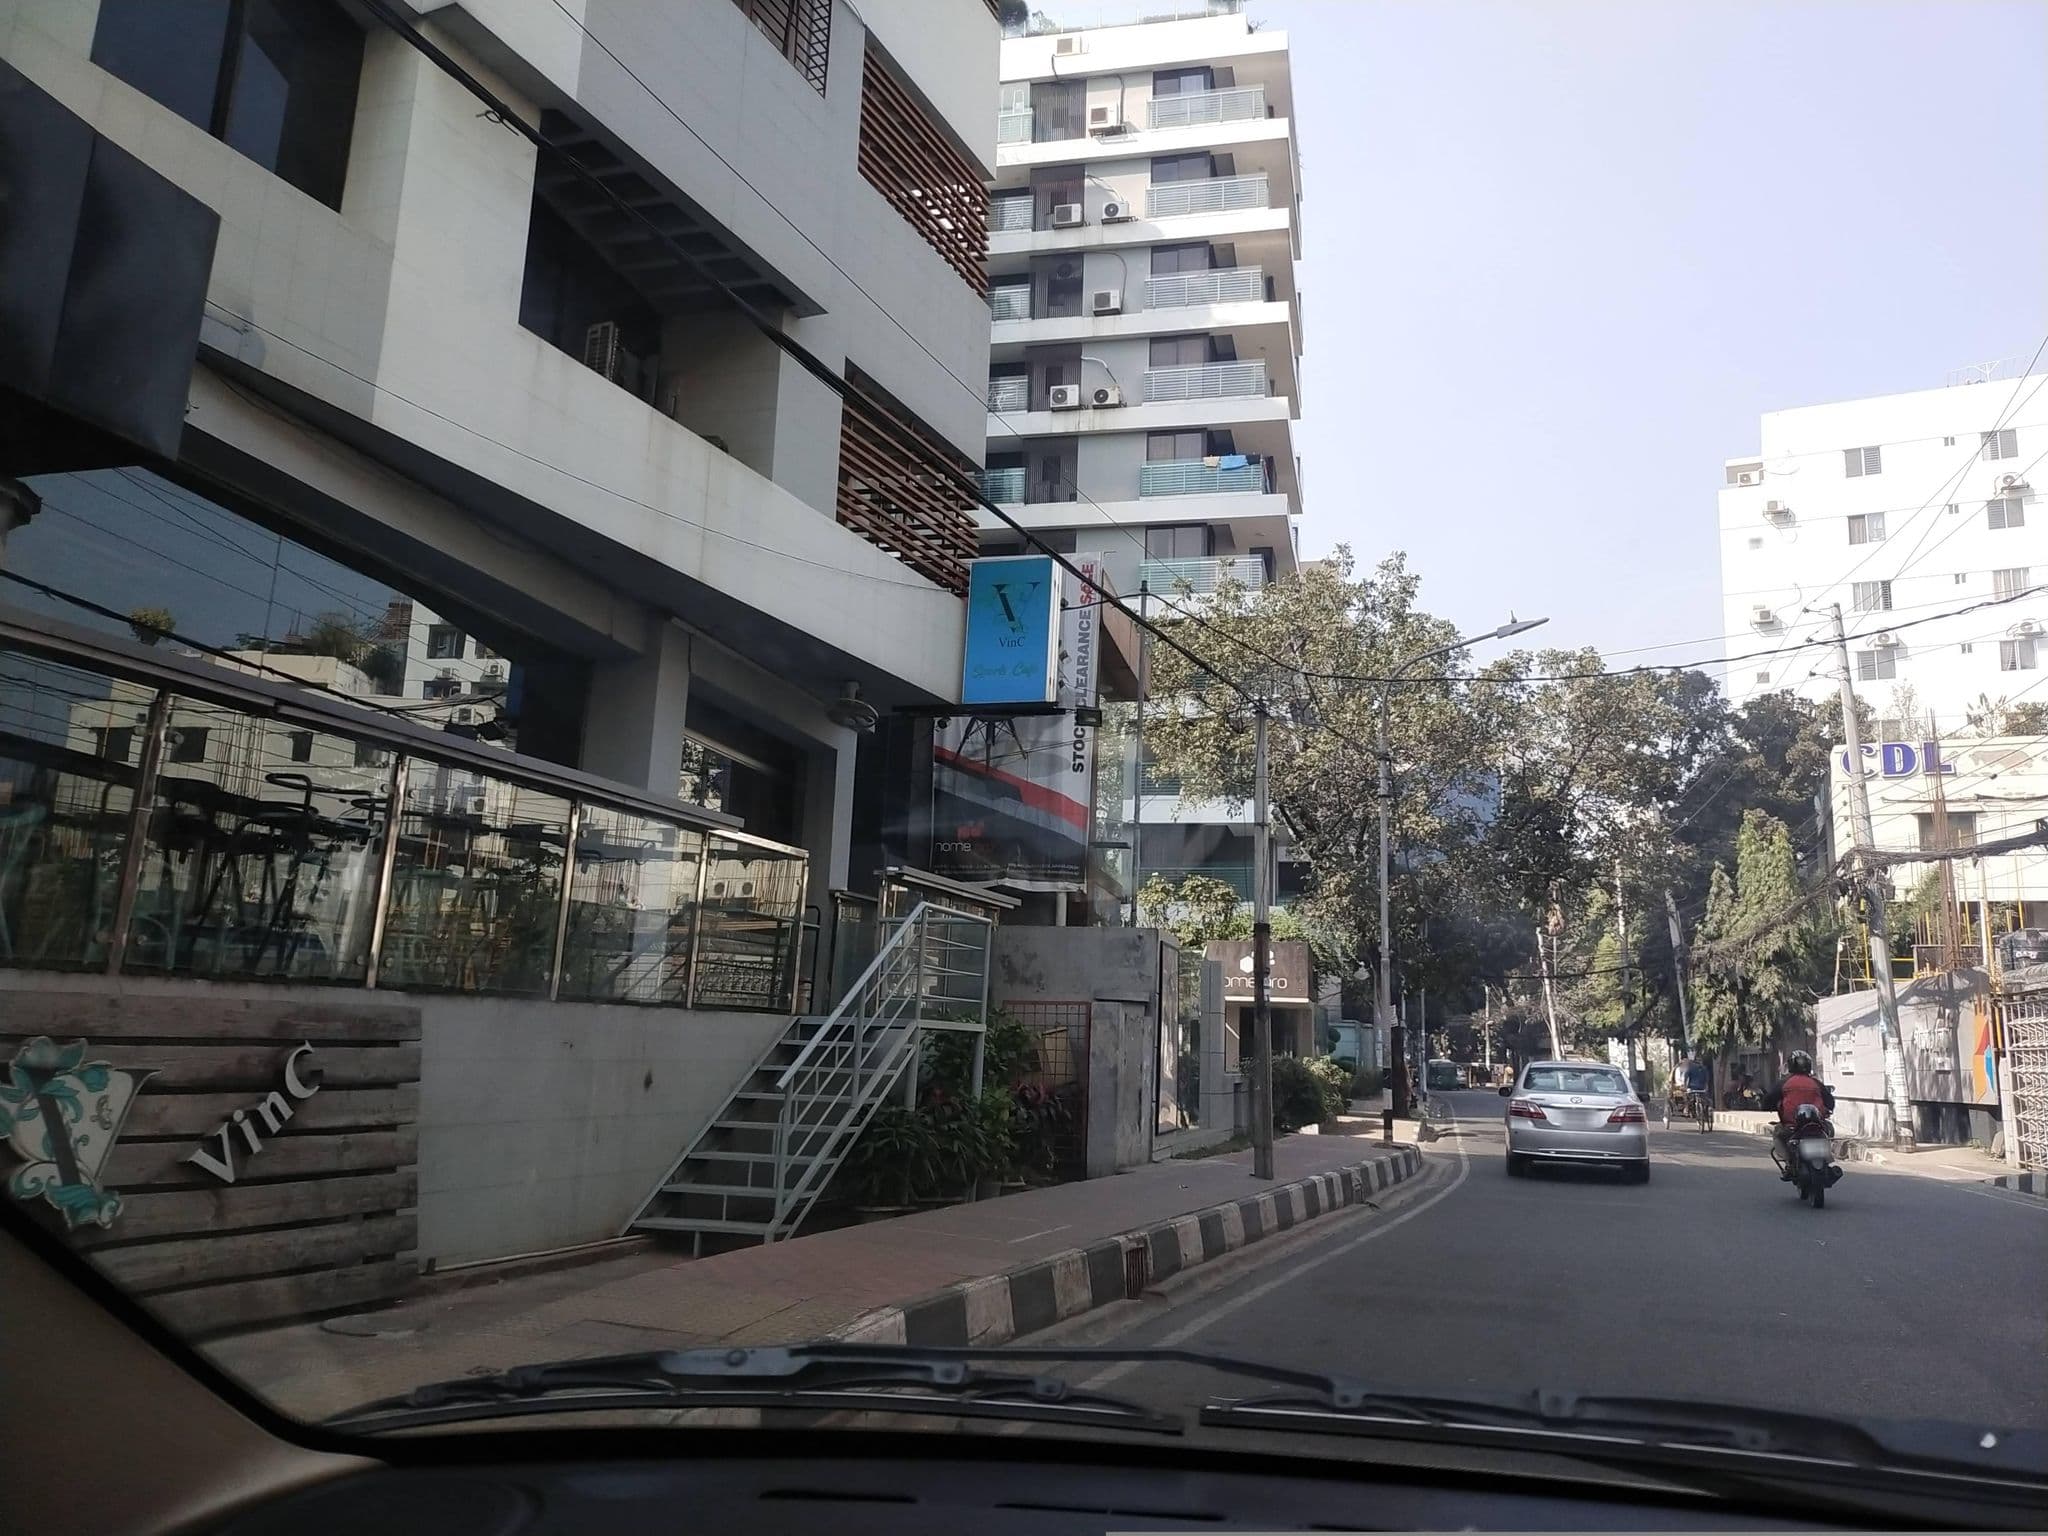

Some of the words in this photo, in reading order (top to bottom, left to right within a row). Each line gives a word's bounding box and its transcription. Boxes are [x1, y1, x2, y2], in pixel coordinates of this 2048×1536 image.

[999, 637, 1025, 648] VinC
[1072, 713, 1087, 773] STOC
[186, 1040, 322, 1183] VinC
